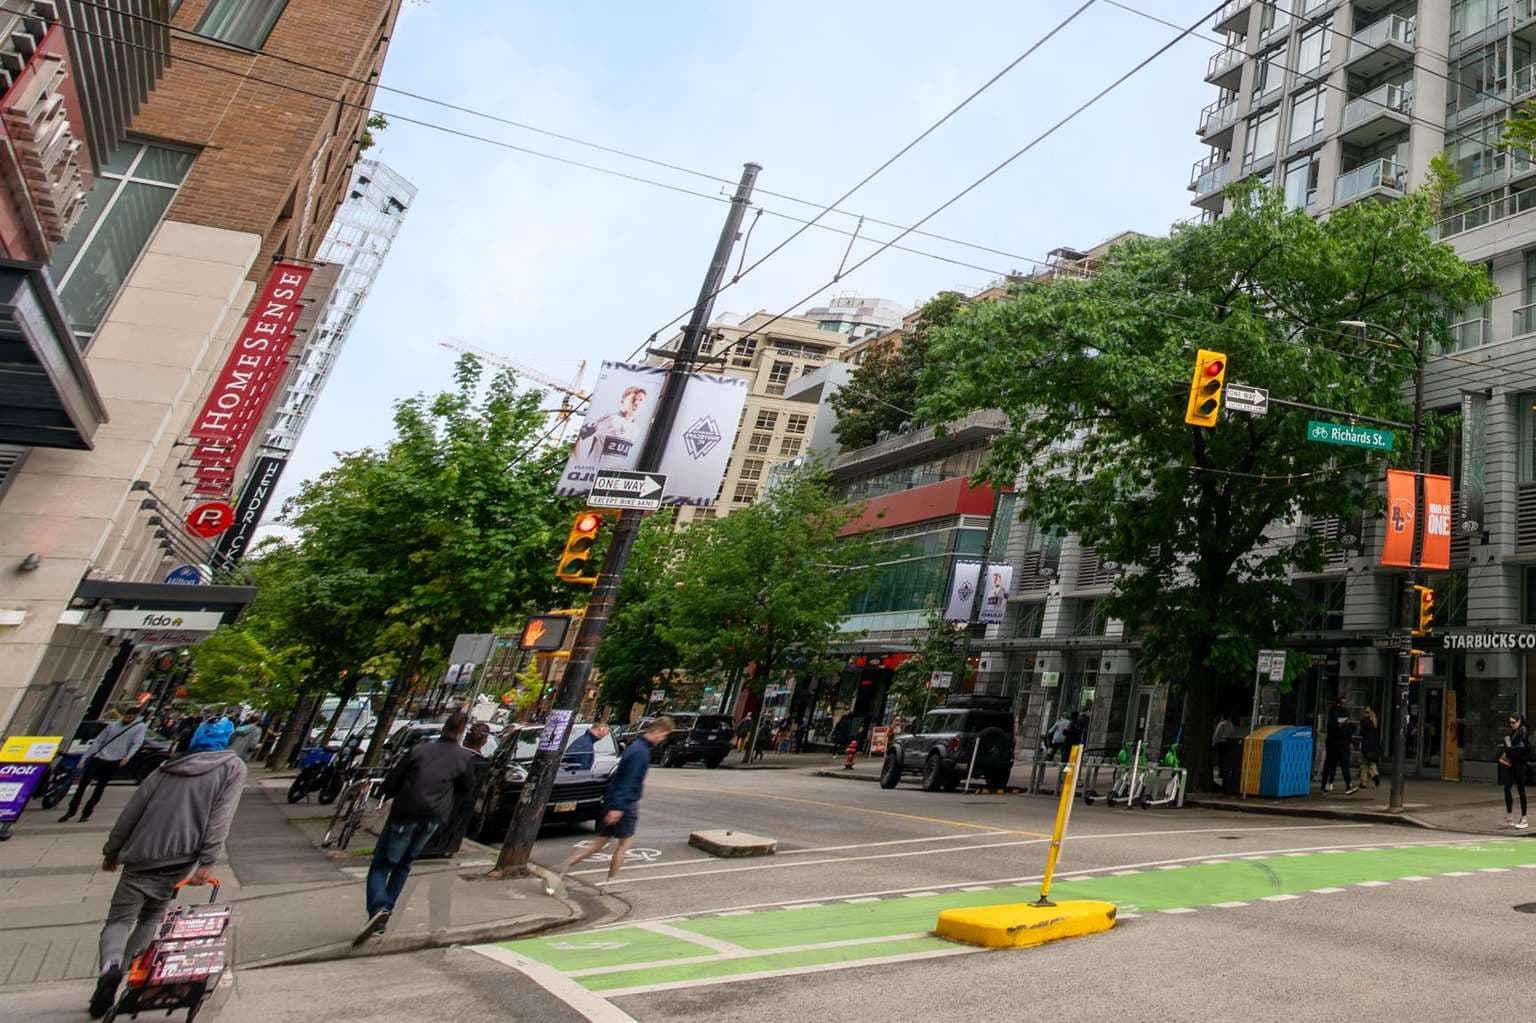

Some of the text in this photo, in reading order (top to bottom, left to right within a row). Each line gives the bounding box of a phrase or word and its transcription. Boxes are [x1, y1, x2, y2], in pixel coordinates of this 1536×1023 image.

[200, 272, 303, 432] HOMESENSE
[1331, 427, 1386, 447] Richards St.
[597, 478, 646, 492] ONE WAY
[1428, 514, 1451, 536] ONE
[142, 614, 172, 627] fido
[1443, 633, 1516, 649] STARBUCKS
